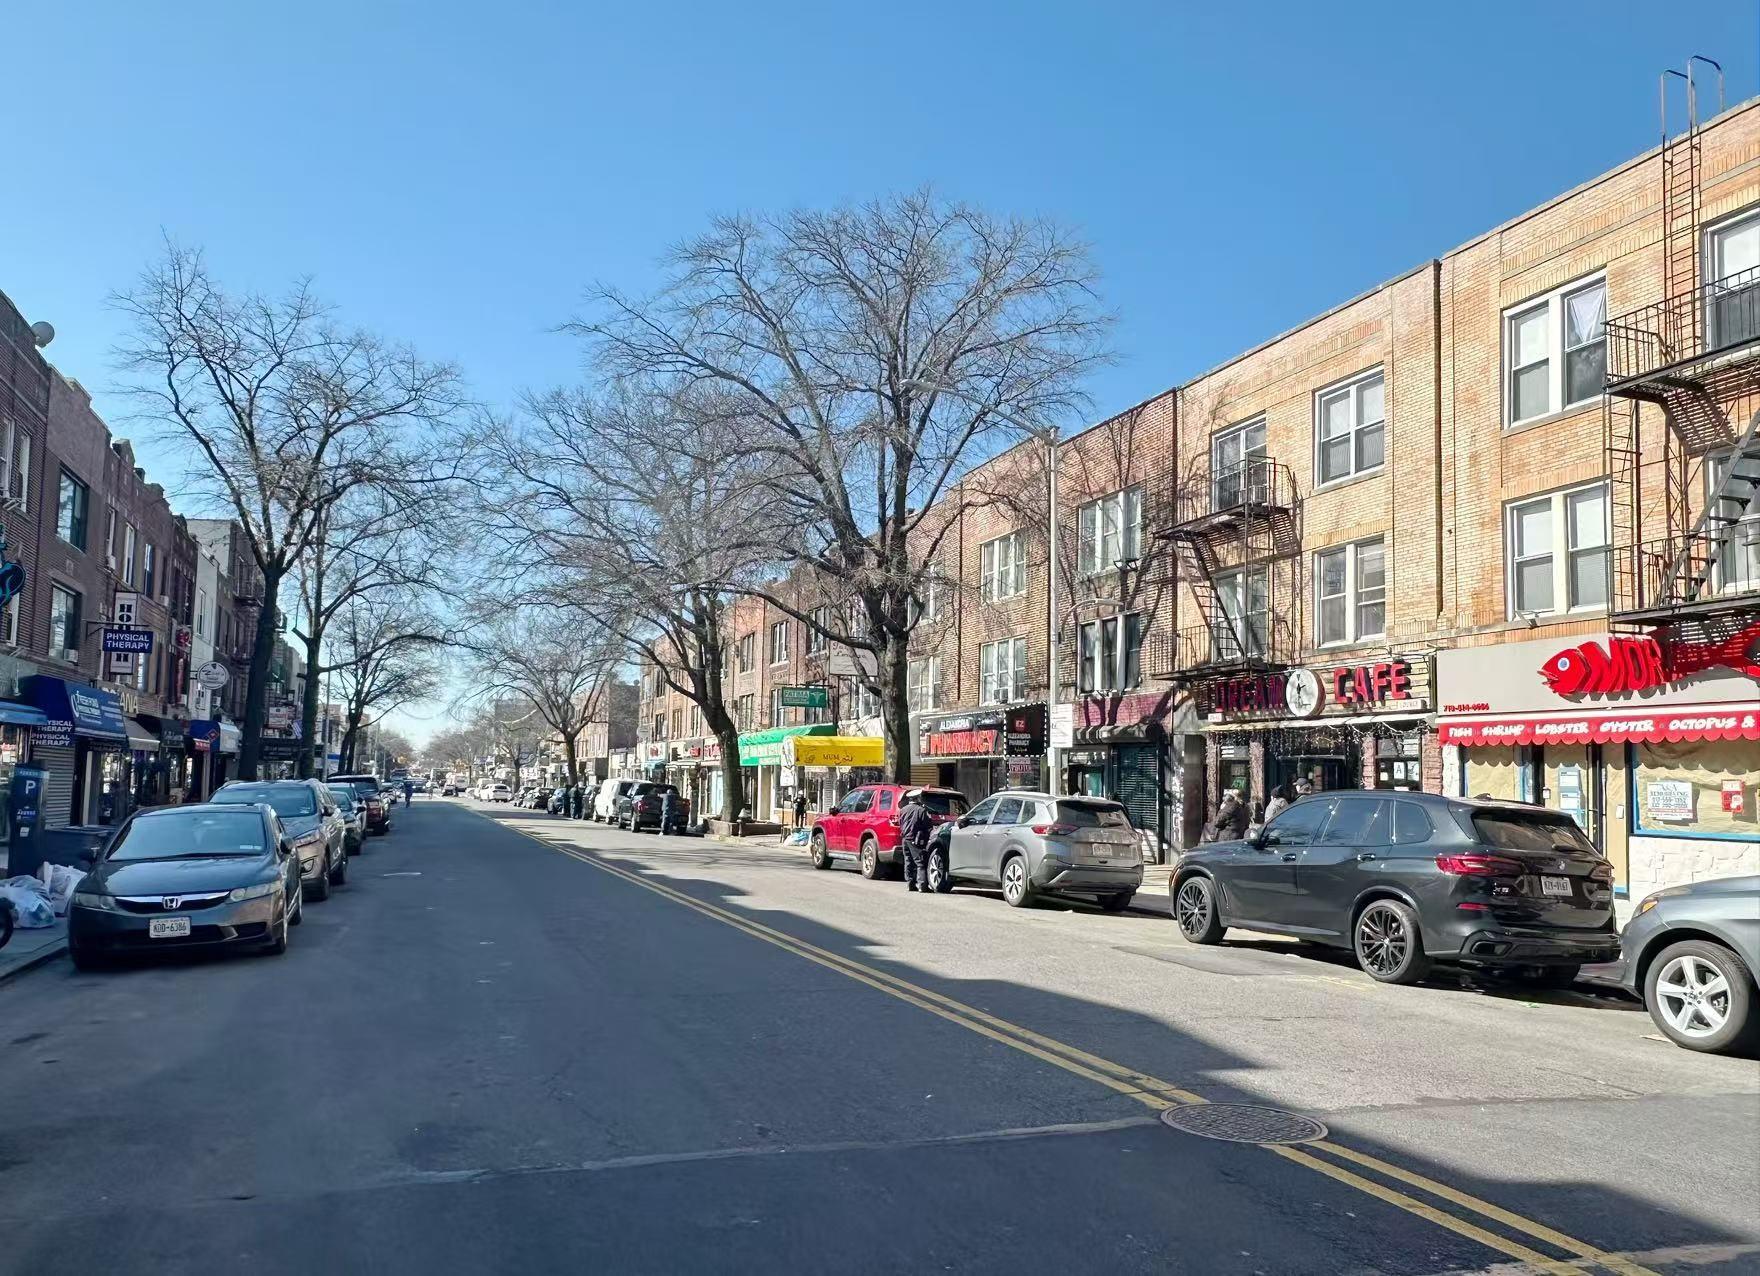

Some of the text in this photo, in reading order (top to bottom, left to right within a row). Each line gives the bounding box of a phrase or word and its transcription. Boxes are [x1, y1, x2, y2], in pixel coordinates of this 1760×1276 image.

[106, 633, 150, 642] PHYSICAL
[106, 640, 150, 650] THERAPY
[1215, 662, 1408, 713] DREAM CAFE
[1481, 724, 1525, 737] SHRIMP
[1535, 722, 1589, 735] LOBSTER
[1600, 719, 1655, 733] OYSTER
[1668, 717, 1737, 731] OCTOPUS
[1741, 715, 1756, 728] &
[930, 730, 997, 755] PHARMACY
[25, 780, 36, 794] P
